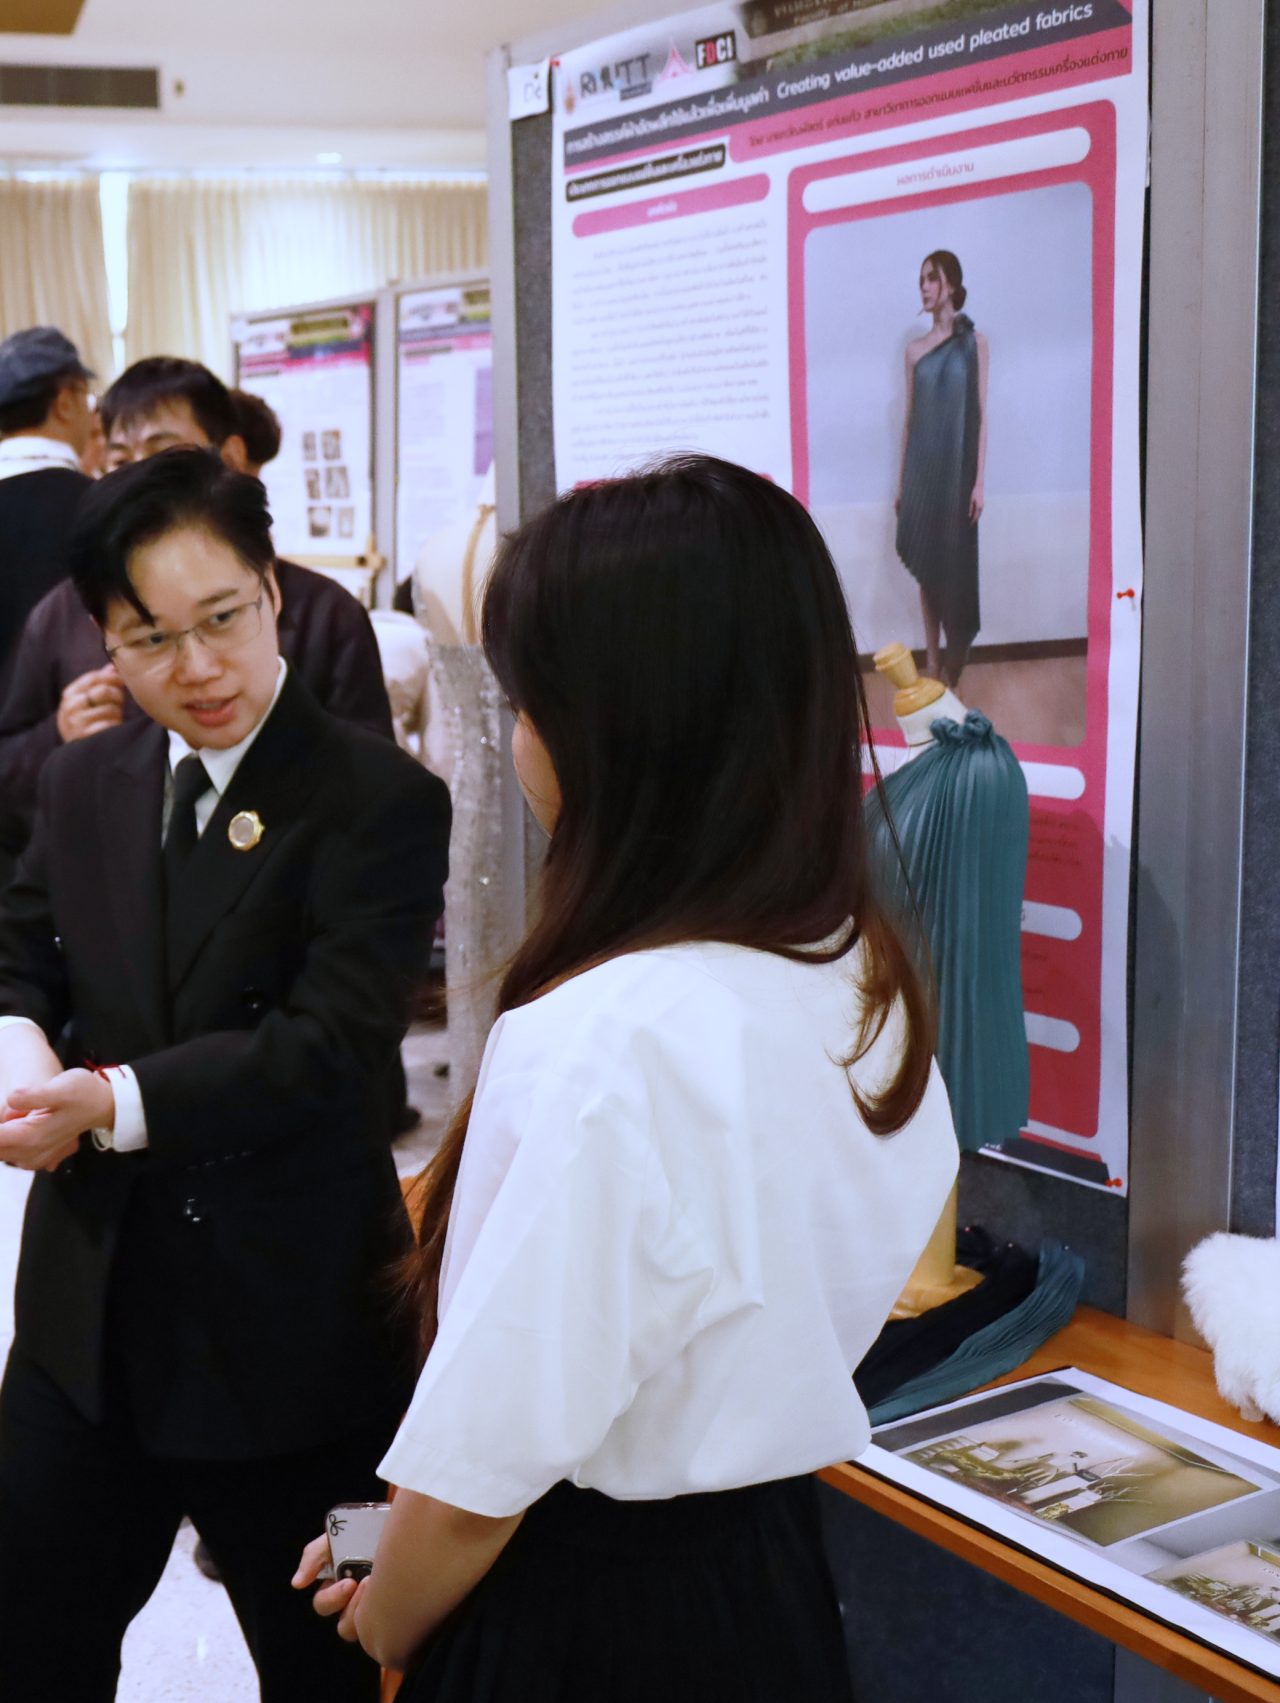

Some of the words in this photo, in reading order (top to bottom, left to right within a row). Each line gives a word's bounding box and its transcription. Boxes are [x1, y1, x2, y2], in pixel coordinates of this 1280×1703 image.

[777, 69, 830, 100] Creating
[835, 44, 924, 82] value-added
[928, 35, 966, 59] used
[969, 19, 1031, 53] pleated
[1036, 1, 1094, 32] fabrics
